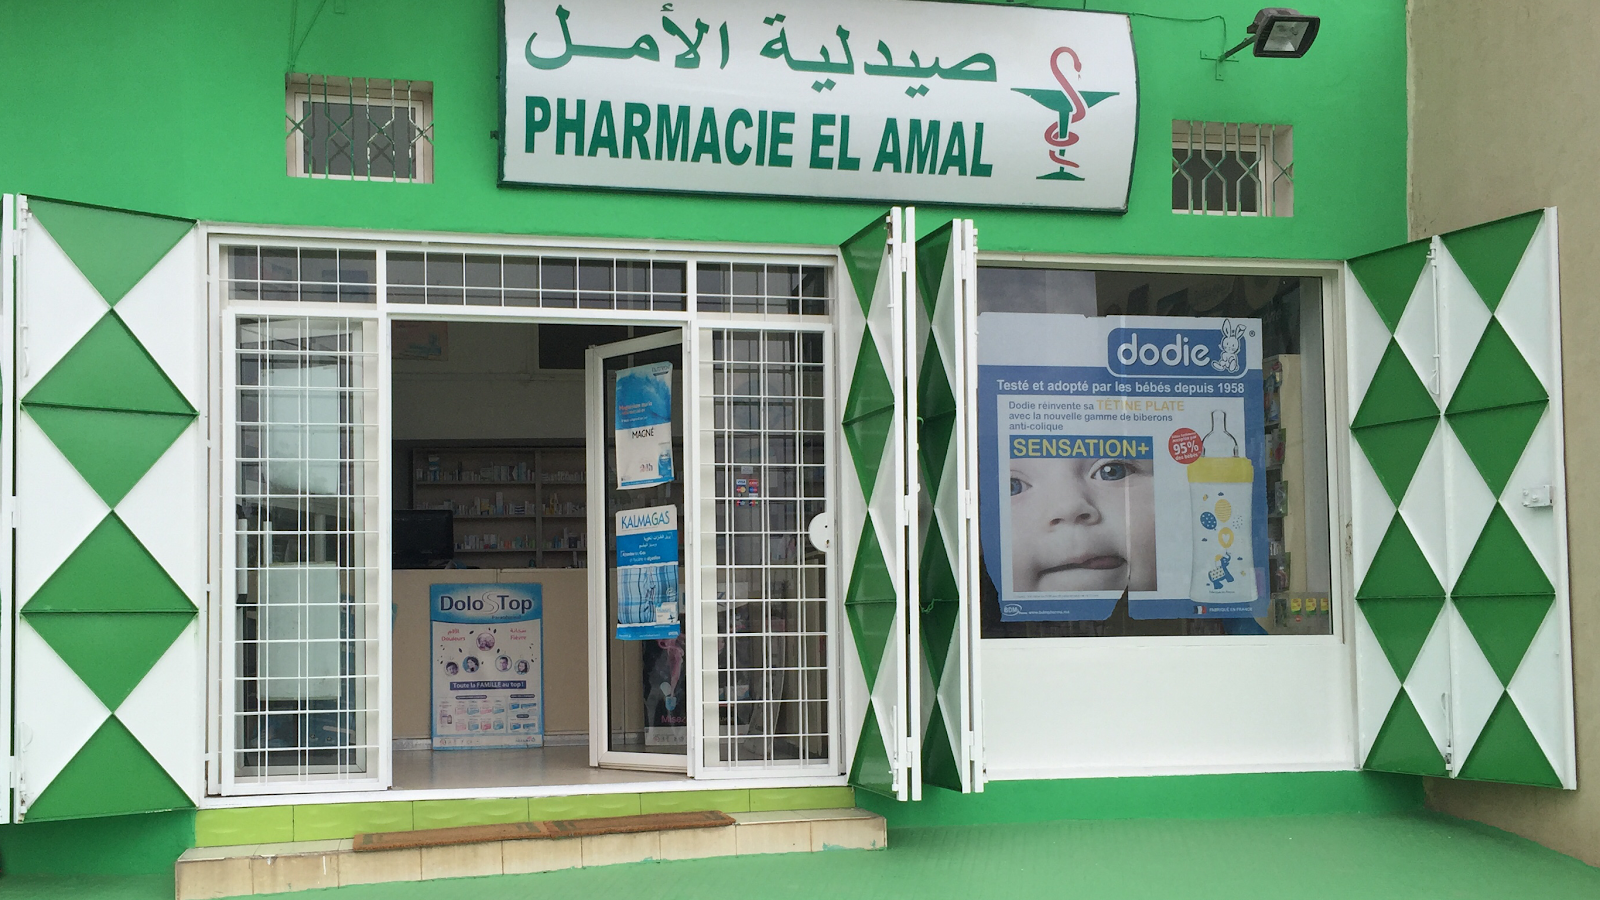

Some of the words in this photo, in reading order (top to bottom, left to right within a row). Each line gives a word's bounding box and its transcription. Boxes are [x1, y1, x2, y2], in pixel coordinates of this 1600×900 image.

[524, 1, 731, 70] الأمل
[758, 13, 998, 99] صيدلية
[524, 95, 796, 169] PHARMACIE
[808, 113, 862, 173] EL
[872, 116, 994, 179] AMAL
[1116, 332, 1211, 367] dodie
[997, 379, 1030, 392] Testé
[1032, 380, 1046, 392] et
[1047, 380, 1089, 395] adopté
[1092, 383, 1112, 396] par
[1115, 380, 1132, 393] les
[1135, 381, 1171, 394] bébés
[1174, 381, 1214, 396] depuis
[1217, 382, 1245, 394] 1958
[1008, 401, 1036, 411] Dodie
[1038, 402, 1082, 411] réinvente
[1083, 403, 1095, 411] sa
[1096, 399, 1142, 411] TÉTINE
[1145, 400, 1185, 412] PLATE
[1008, 412, 1031, 421] avec
[1033, 411, 1042, 421] la
[1043, 411, 1083, 421] nouvelle
[1084, 413, 1118, 423] gamme
[1119, 412, 1131, 422] de
[1133, 412, 1173, 422] biberons
[1008, 421, 1064, 432] anti-colique
[1013, 437, 1150, 458] SENSATION+
[1173, 440, 1199, 455] 95%
[621, 510, 670, 529] KALMAGAS
